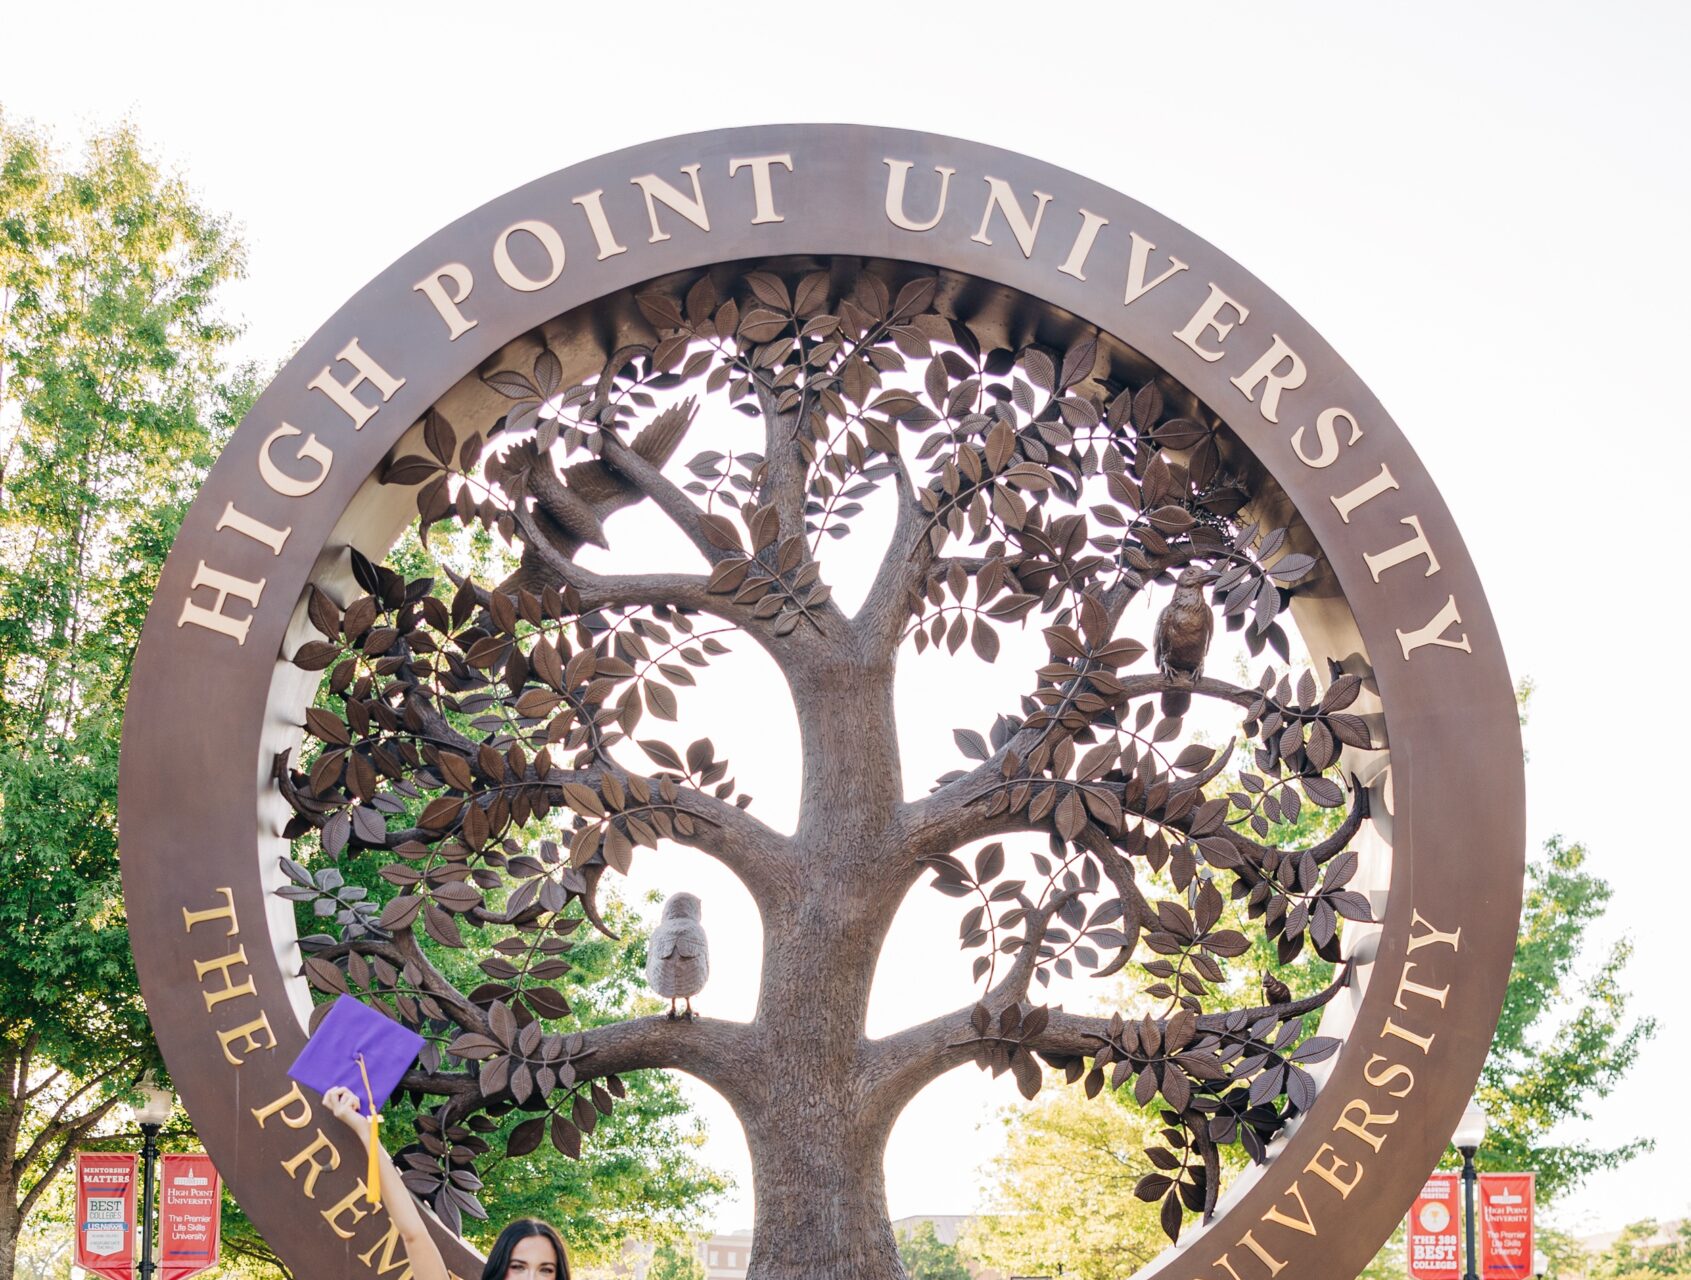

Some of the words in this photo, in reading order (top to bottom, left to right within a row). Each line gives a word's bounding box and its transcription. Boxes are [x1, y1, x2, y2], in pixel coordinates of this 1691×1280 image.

[177, 337, 406, 646] HIGH
[413, 154, 794, 341] POINT
[883, 158, 1472, 661] UNIVERSITY
[183, 887, 278, 1065] THE
[84, 1175, 130, 1183] MATTERS
[168, 1188, 189, 1196] HIGH
[191, 1188, 214, 1197] POINT
[168, 1196, 213, 1205] UNIVERSITY
[90, 1201, 121, 1211] BEST
[1485, 1206, 1504, 1214] HIGH
[1506, 1206, 1528, 1214] POINT
[89, 1211, 121, 1220] COLLEGES
[168, 1214, 183, 1222] The
[184, 1214, 211, 1222] Premier
[1485, 1214, 1528, 1223] UNIVERSITY
[174, 1223, 187, 1231] Life
[188, 1223, 206, 1231] Skills
[172, 1232, 207, 1241] University
[1412, 1235, 1436, 1245] THE
[1413, 1245, 1457, 1260] BEST
[1412, 1260, 1457, 1270] COLLEGES
